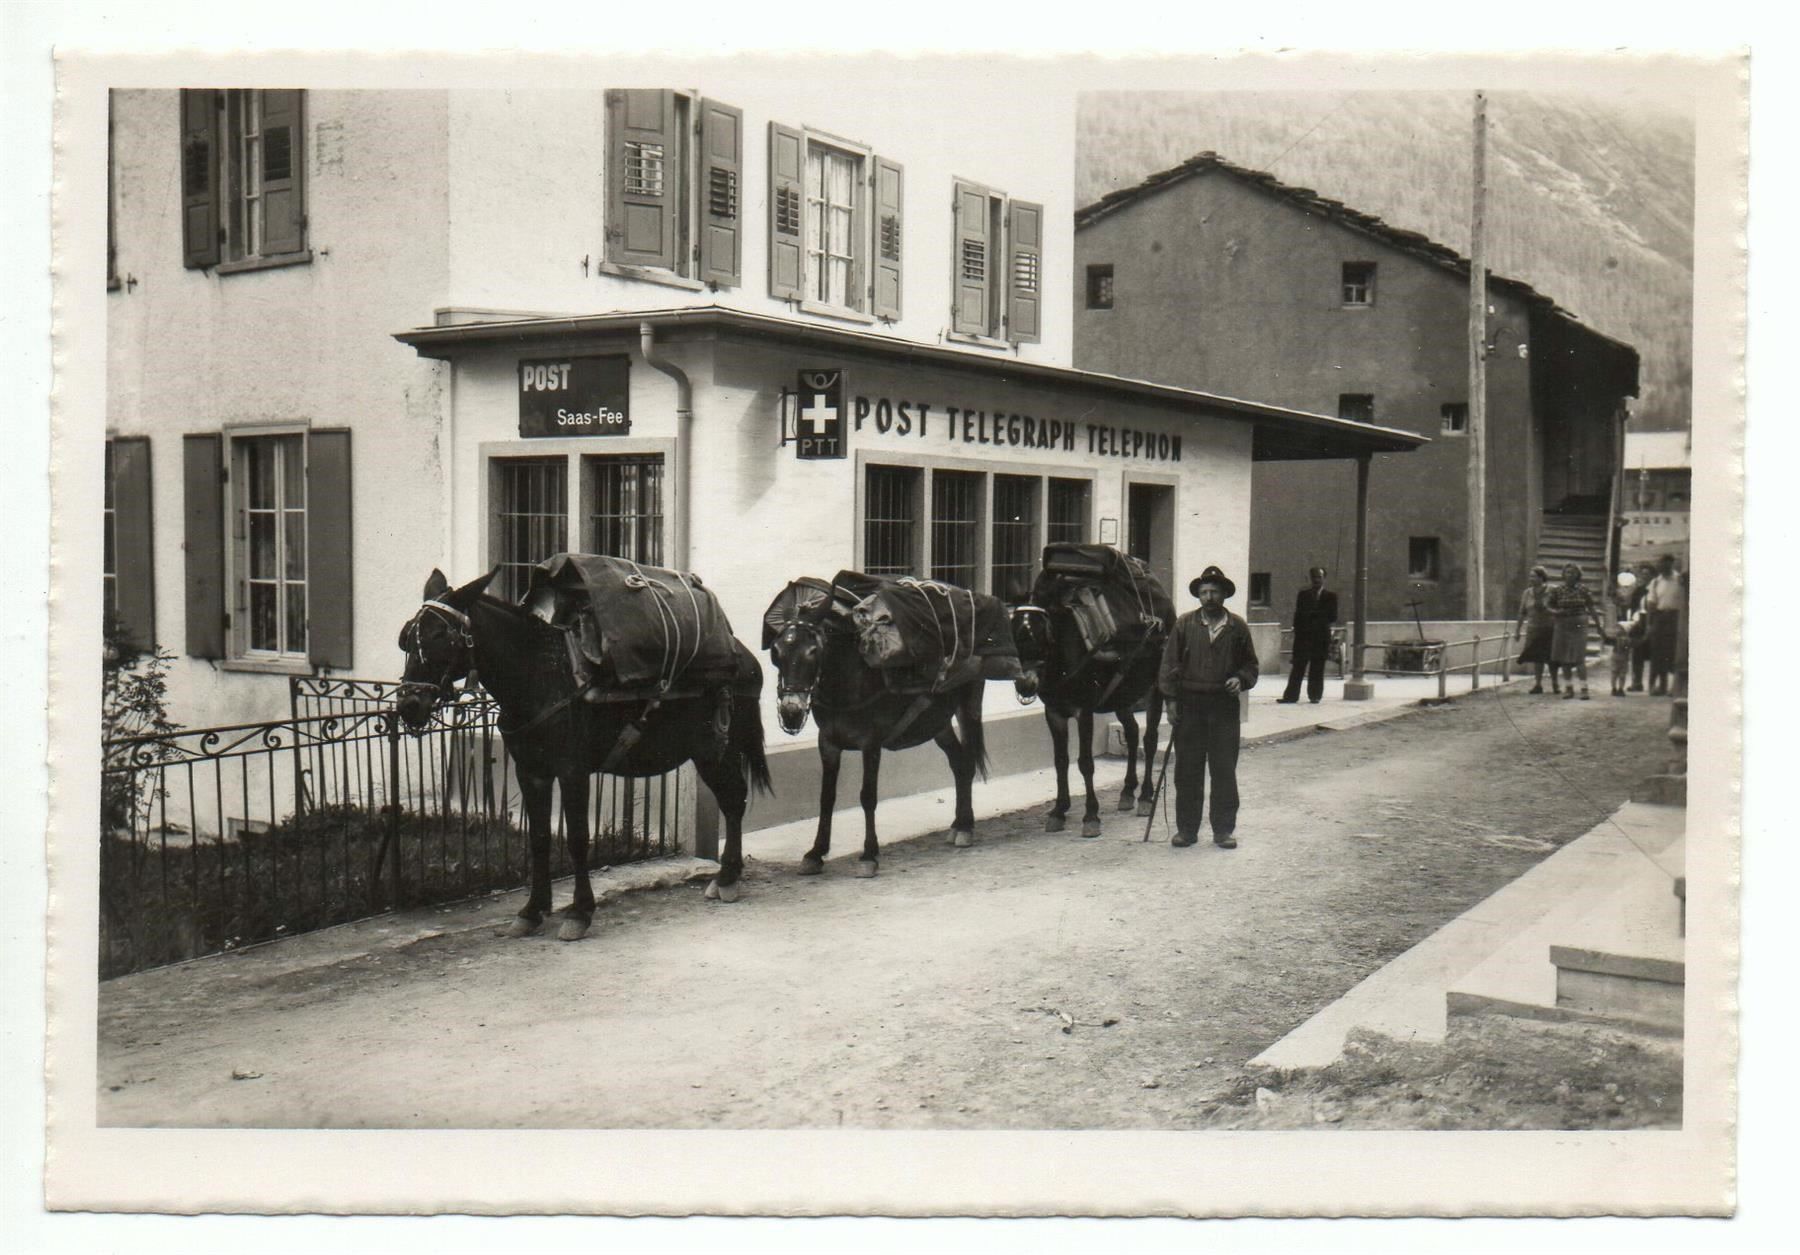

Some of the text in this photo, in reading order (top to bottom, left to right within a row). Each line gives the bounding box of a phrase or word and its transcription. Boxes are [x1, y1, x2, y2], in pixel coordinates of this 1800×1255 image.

[523, 364, 571, 392] POST
[557, 407, 624, 426] Saas-Fee
[855, 396, 1183, 462] POST TELEGRAPH TELEPHON
[802, 438, 838, 455] PTT
